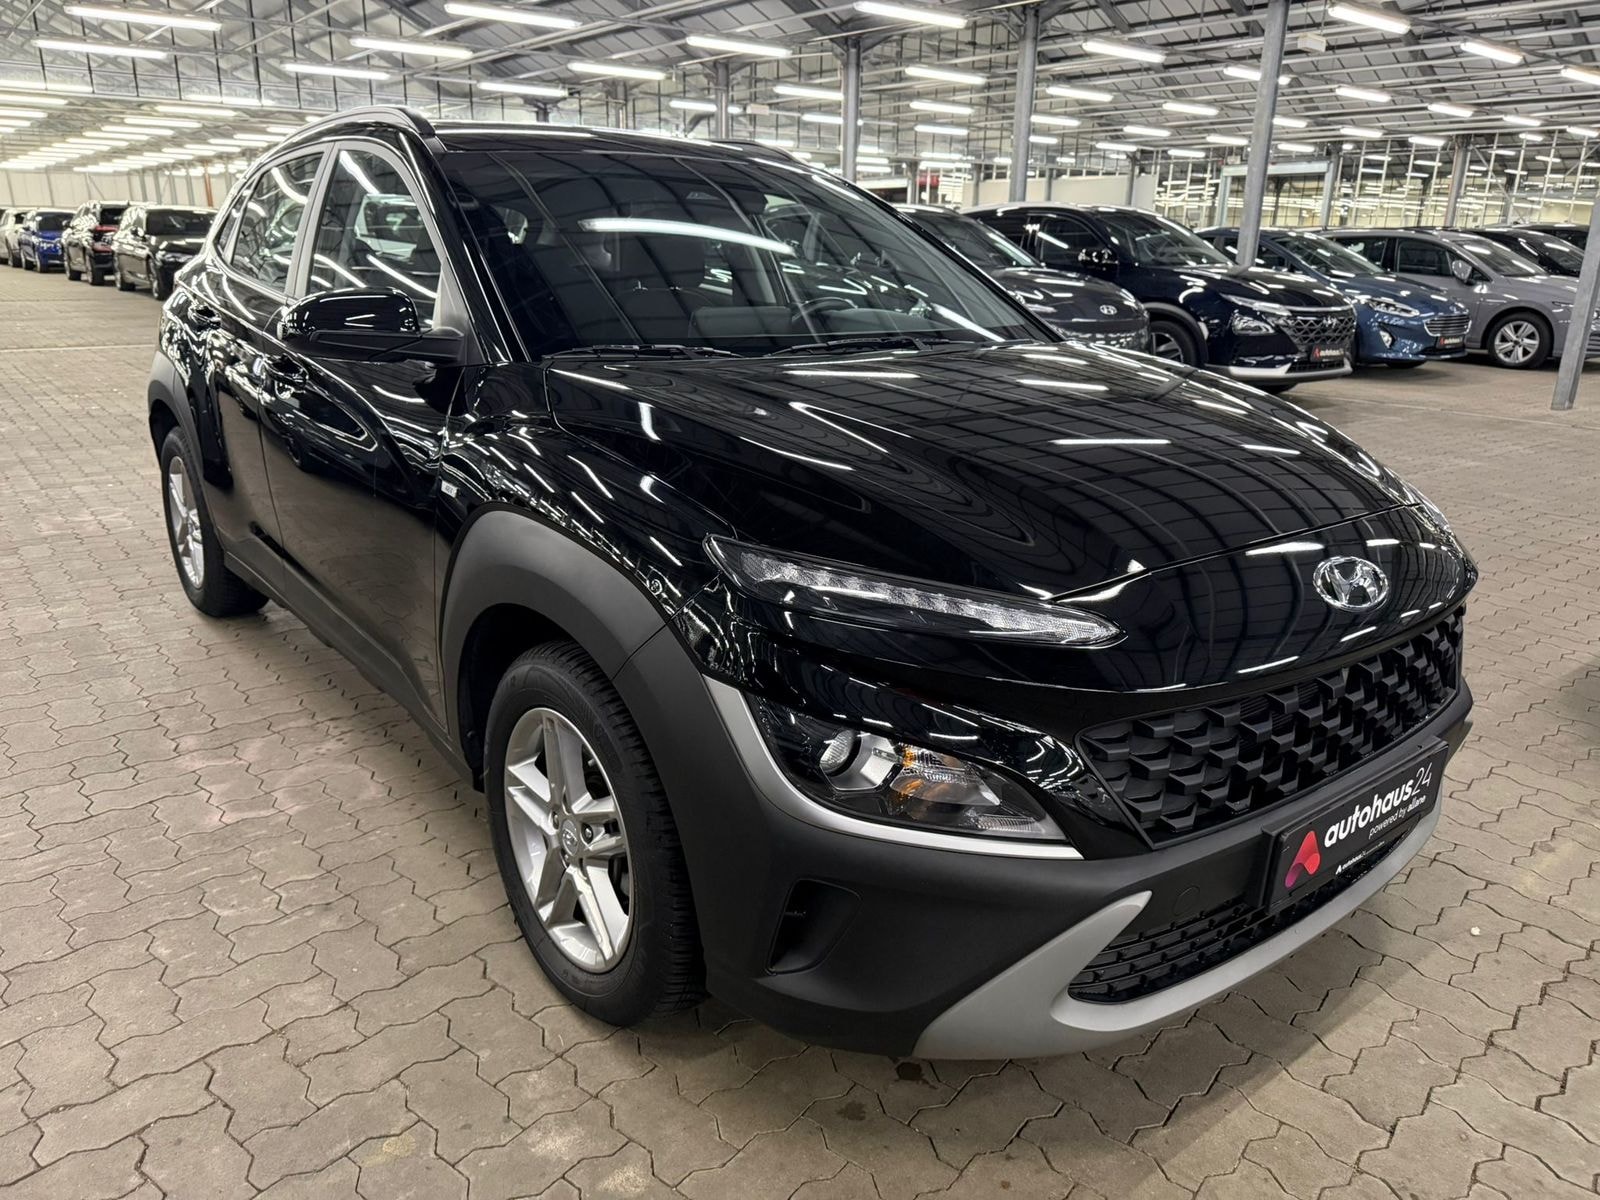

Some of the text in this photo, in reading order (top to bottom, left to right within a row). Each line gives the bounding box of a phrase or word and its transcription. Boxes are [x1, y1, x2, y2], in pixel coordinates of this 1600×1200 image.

[1324, 762, 1433, 848] autohaus24
[1368, 810, 1399, 840] powered
[1398, 807, 1408, 819] by
